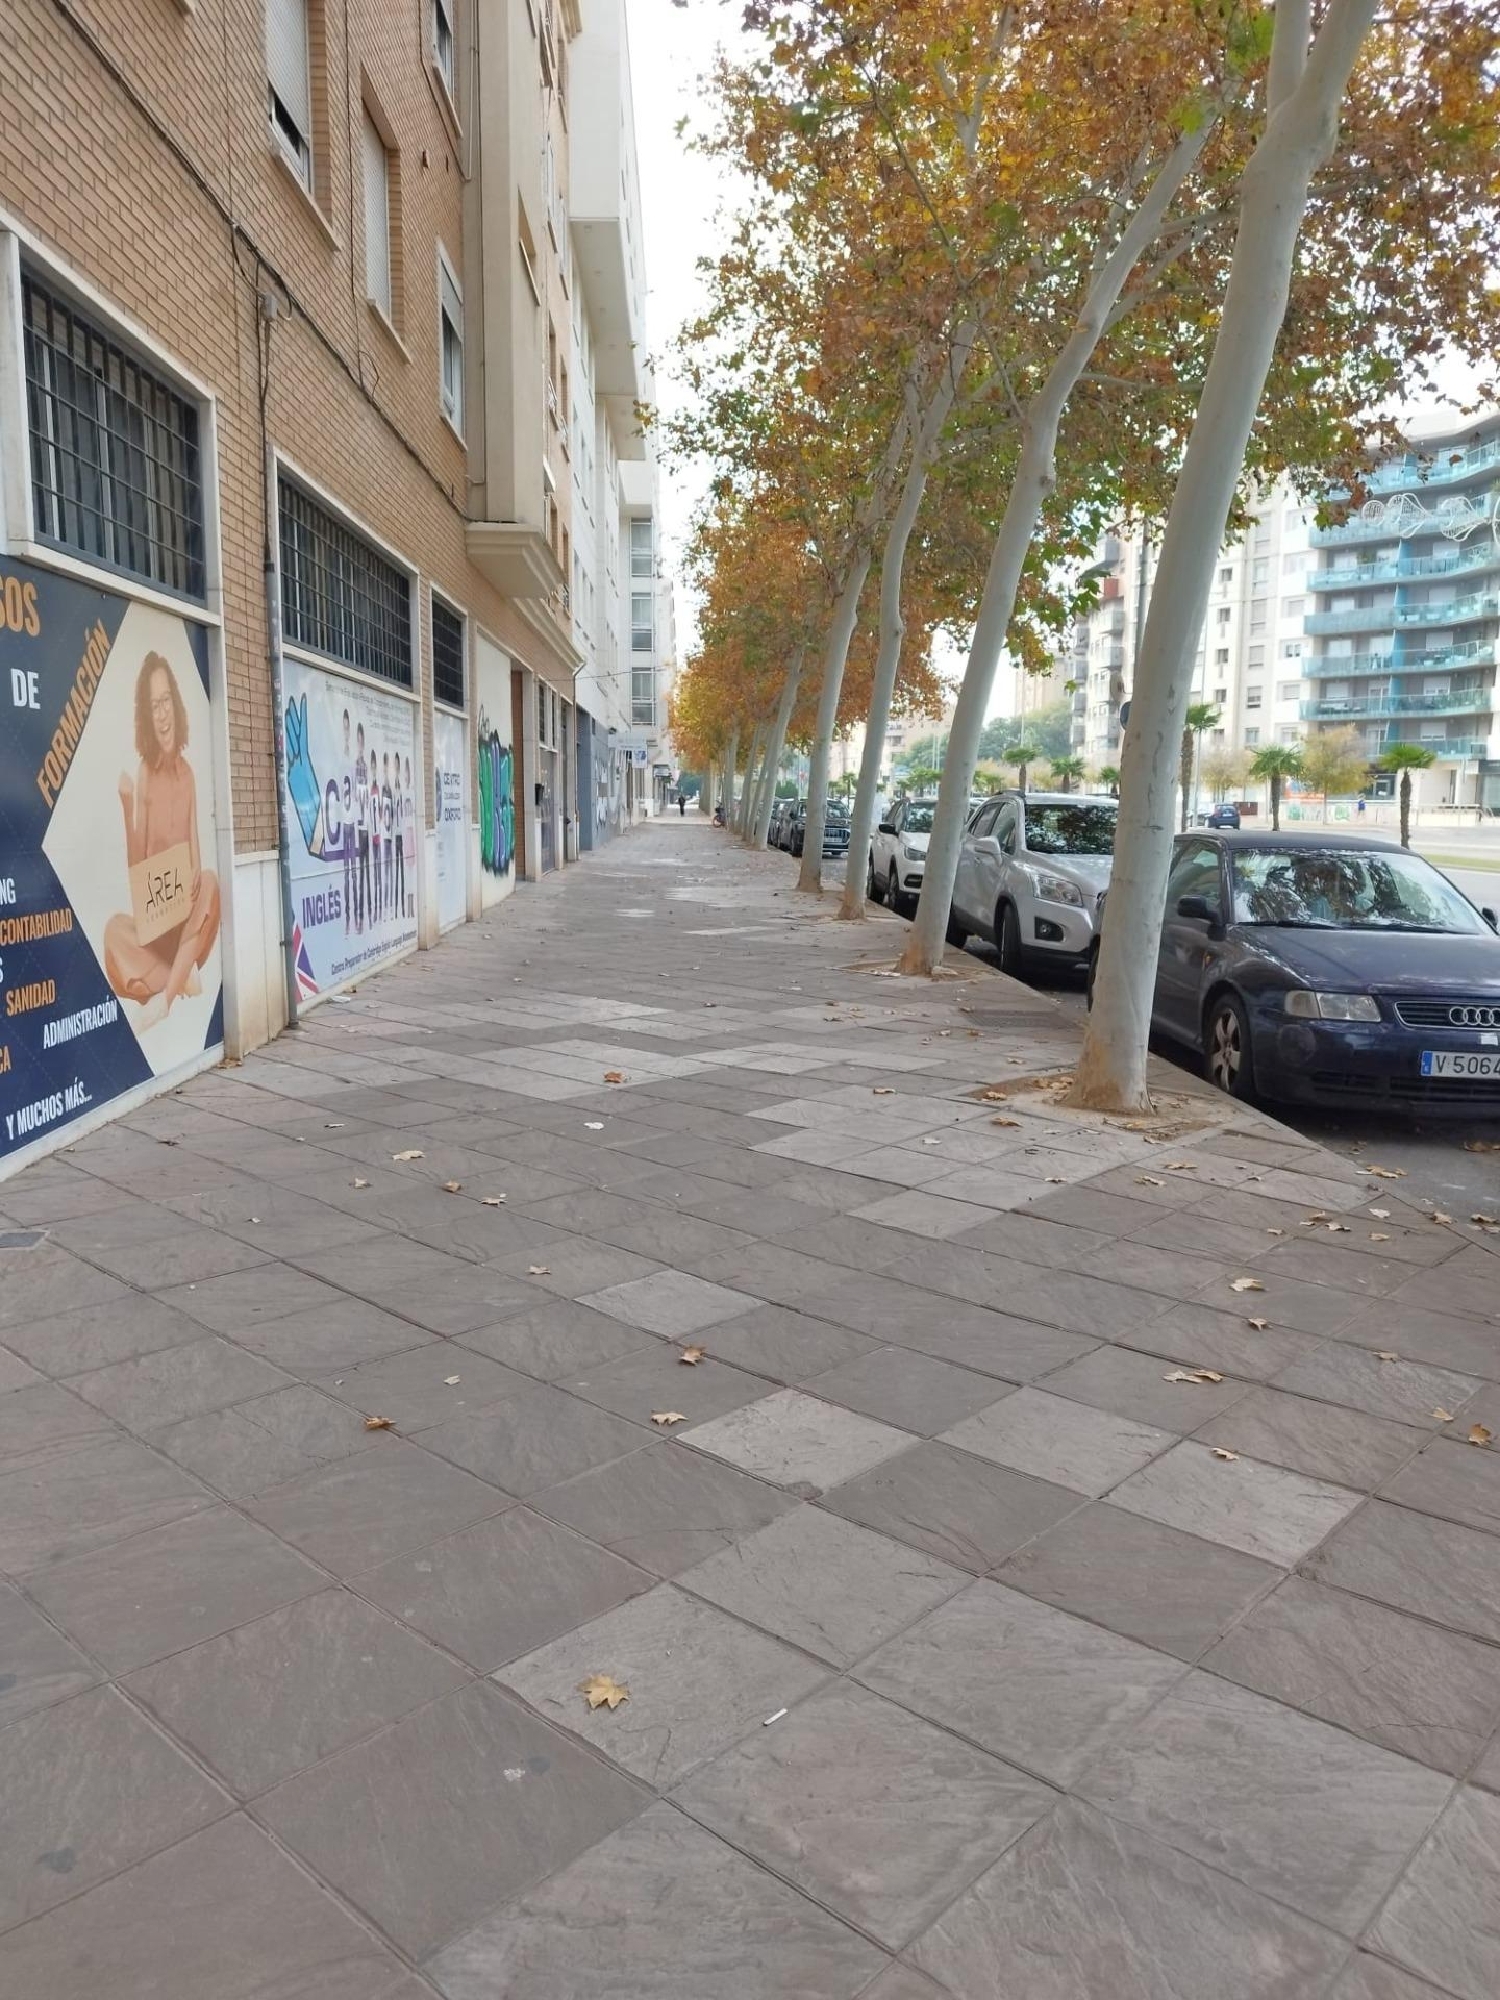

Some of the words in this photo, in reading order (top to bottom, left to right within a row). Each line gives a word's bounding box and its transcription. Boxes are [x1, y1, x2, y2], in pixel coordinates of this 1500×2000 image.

[0, 575, 41, 638] OS
[10, 667, 41, 710] DE
[37, 618, 111, 809] FORMACIÓN
[0, 907, 73, 947] CONTABILIDAD
[302, 883, 342, 930] INGLÉS
[6, 978, 56, 1018] SANIDAD
[43, 994, 119, 1050] ADMINISTRACIÓN
[5, 1113, 15, 1141] Y
[16, 1091, 64, 1136] MUCHOS
